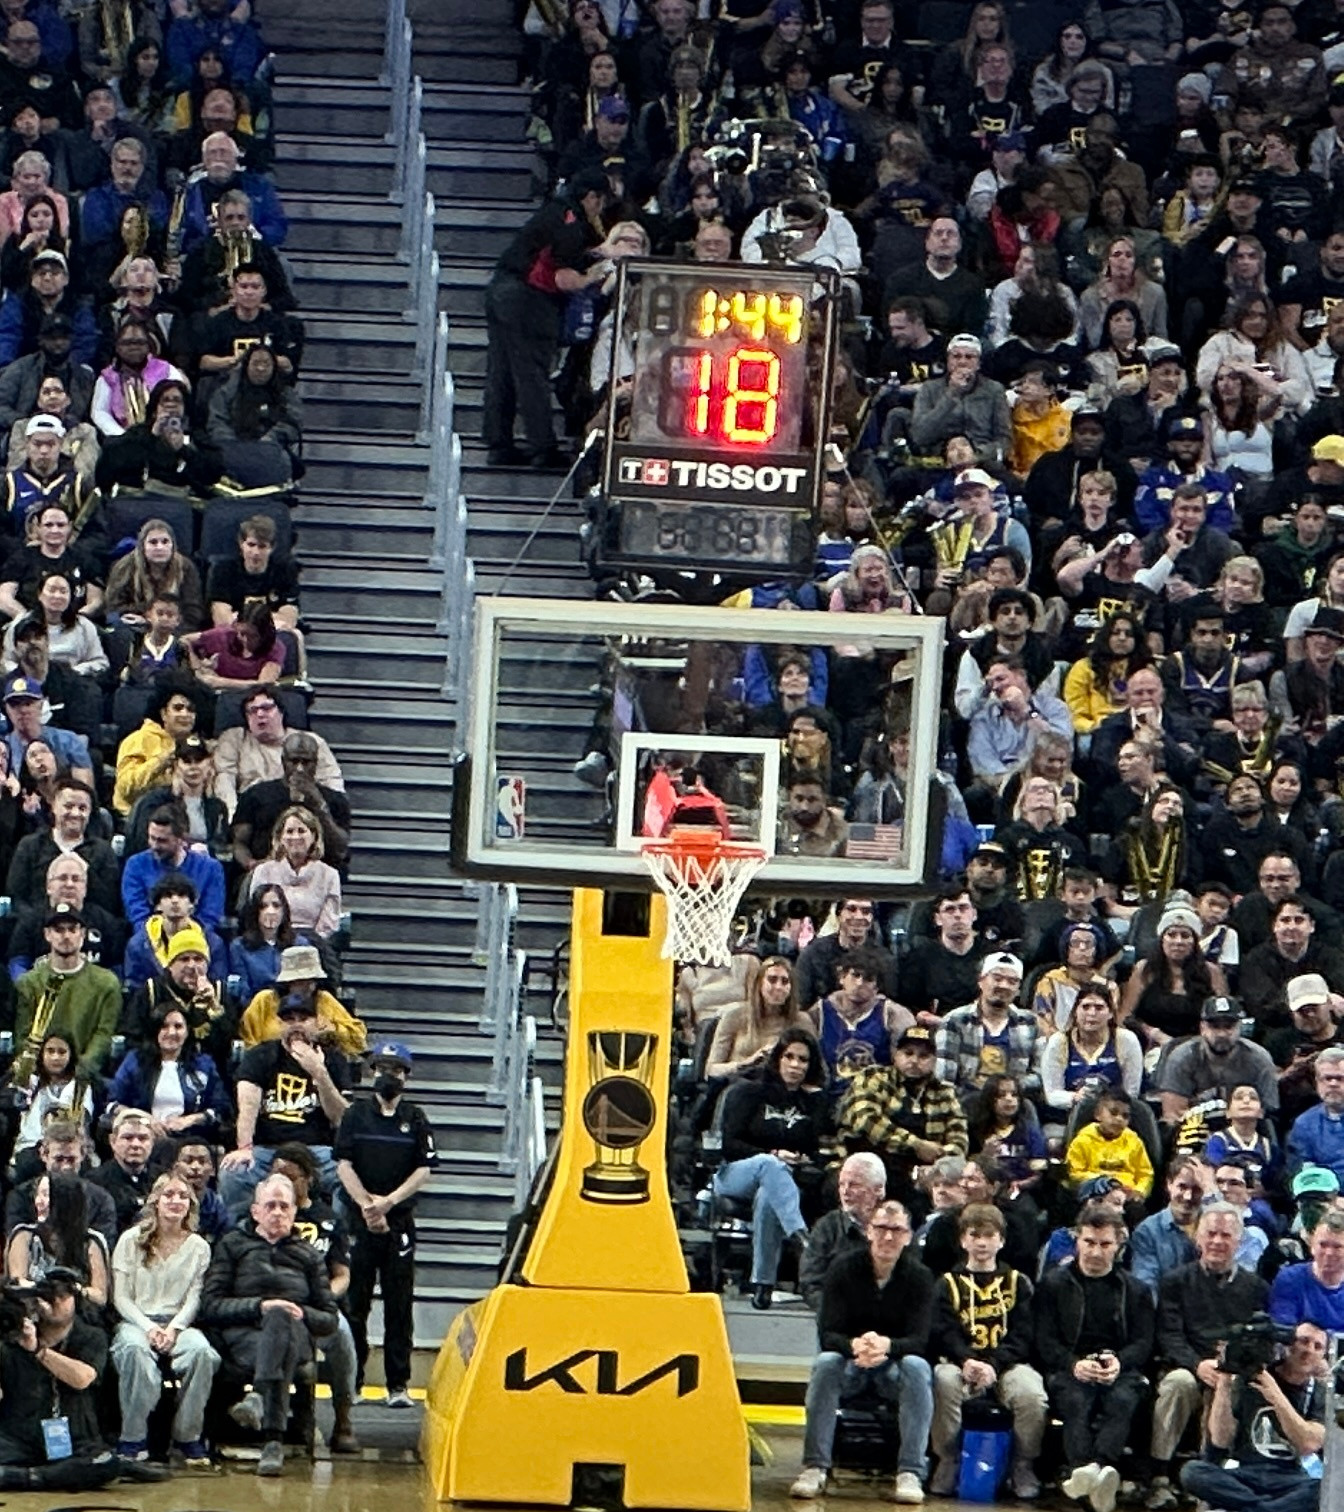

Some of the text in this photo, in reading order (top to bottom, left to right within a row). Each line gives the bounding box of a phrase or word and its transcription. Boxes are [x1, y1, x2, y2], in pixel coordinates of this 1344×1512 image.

[700, 289, 804, 344] 1:44
[696, 348, 782, 443] 18
[671, 460, 807, 493] TISSOT
[504, 1346, 700, 1398] KIA
